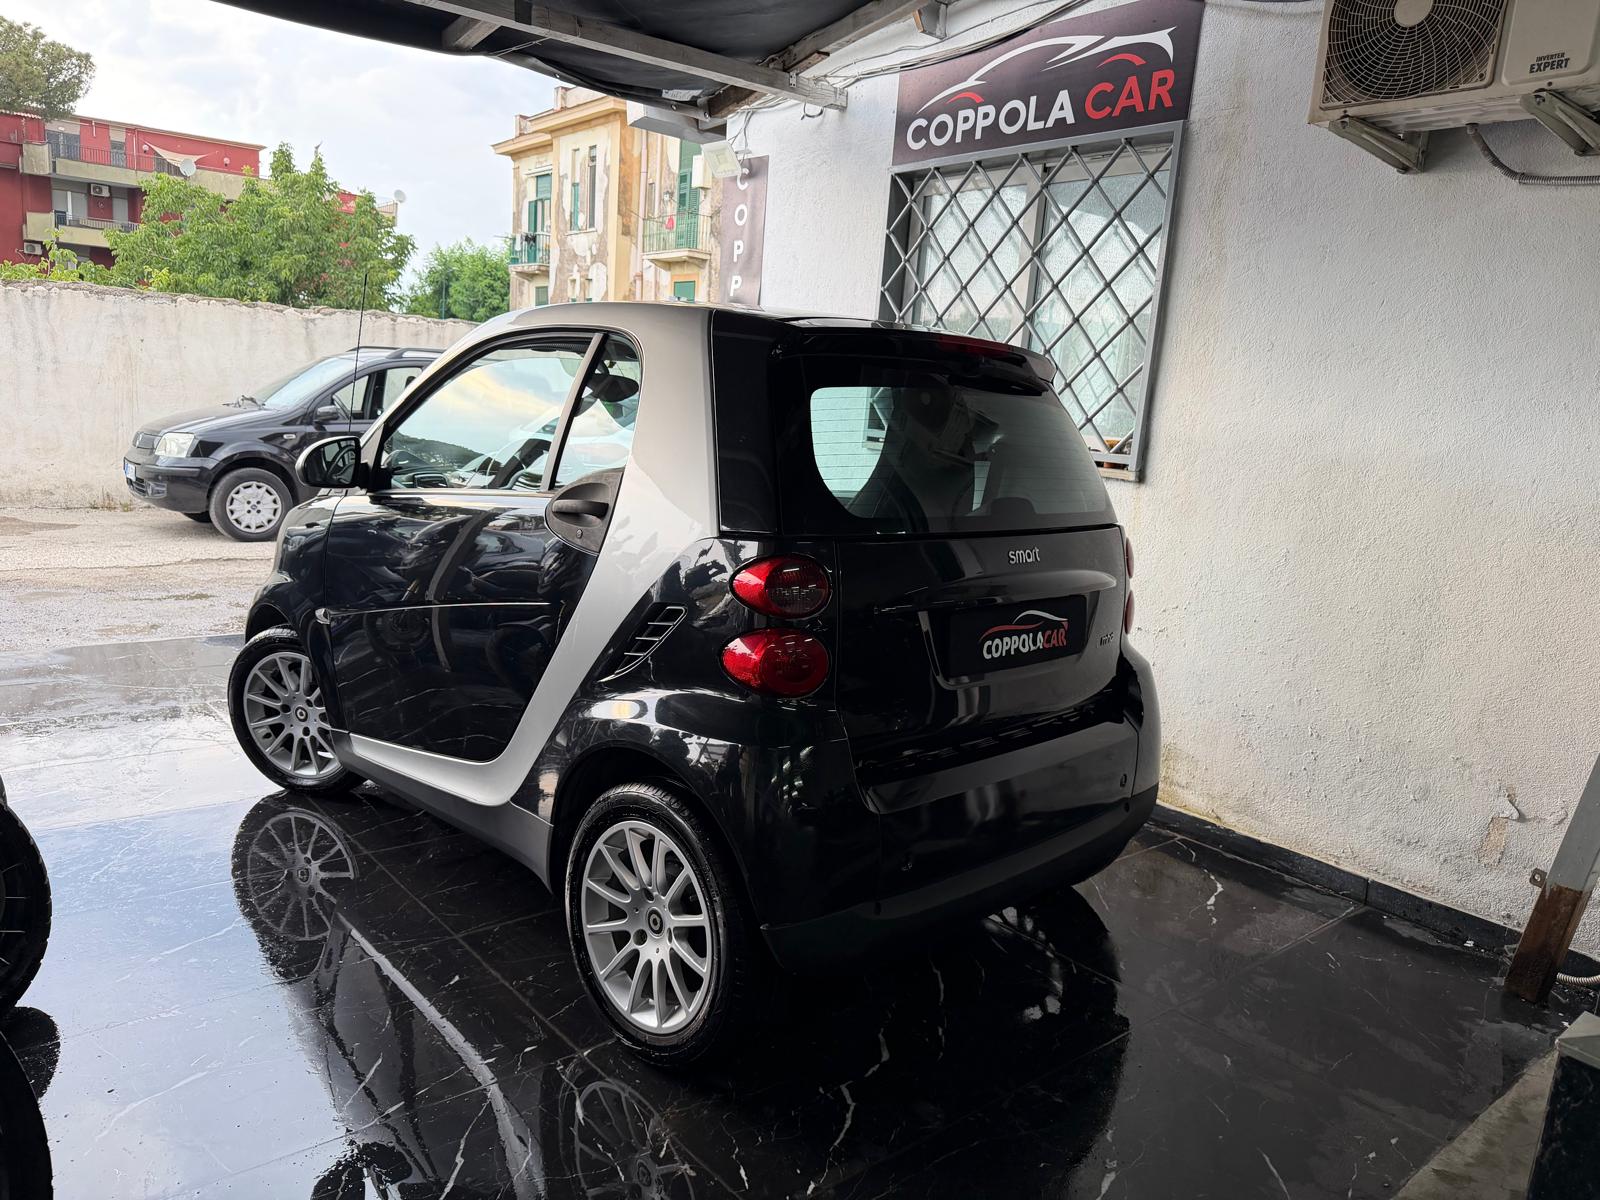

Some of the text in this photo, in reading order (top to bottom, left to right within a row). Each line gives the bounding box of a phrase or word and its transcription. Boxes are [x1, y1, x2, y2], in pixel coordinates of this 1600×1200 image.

[1536, 52, 1565, 62] INVERTER
[1529, 58, 1570, 74] EXPERT
[906, 69, 1175, 151] COPPOLA CAR
[1008, 546, 1041, 564] smart
